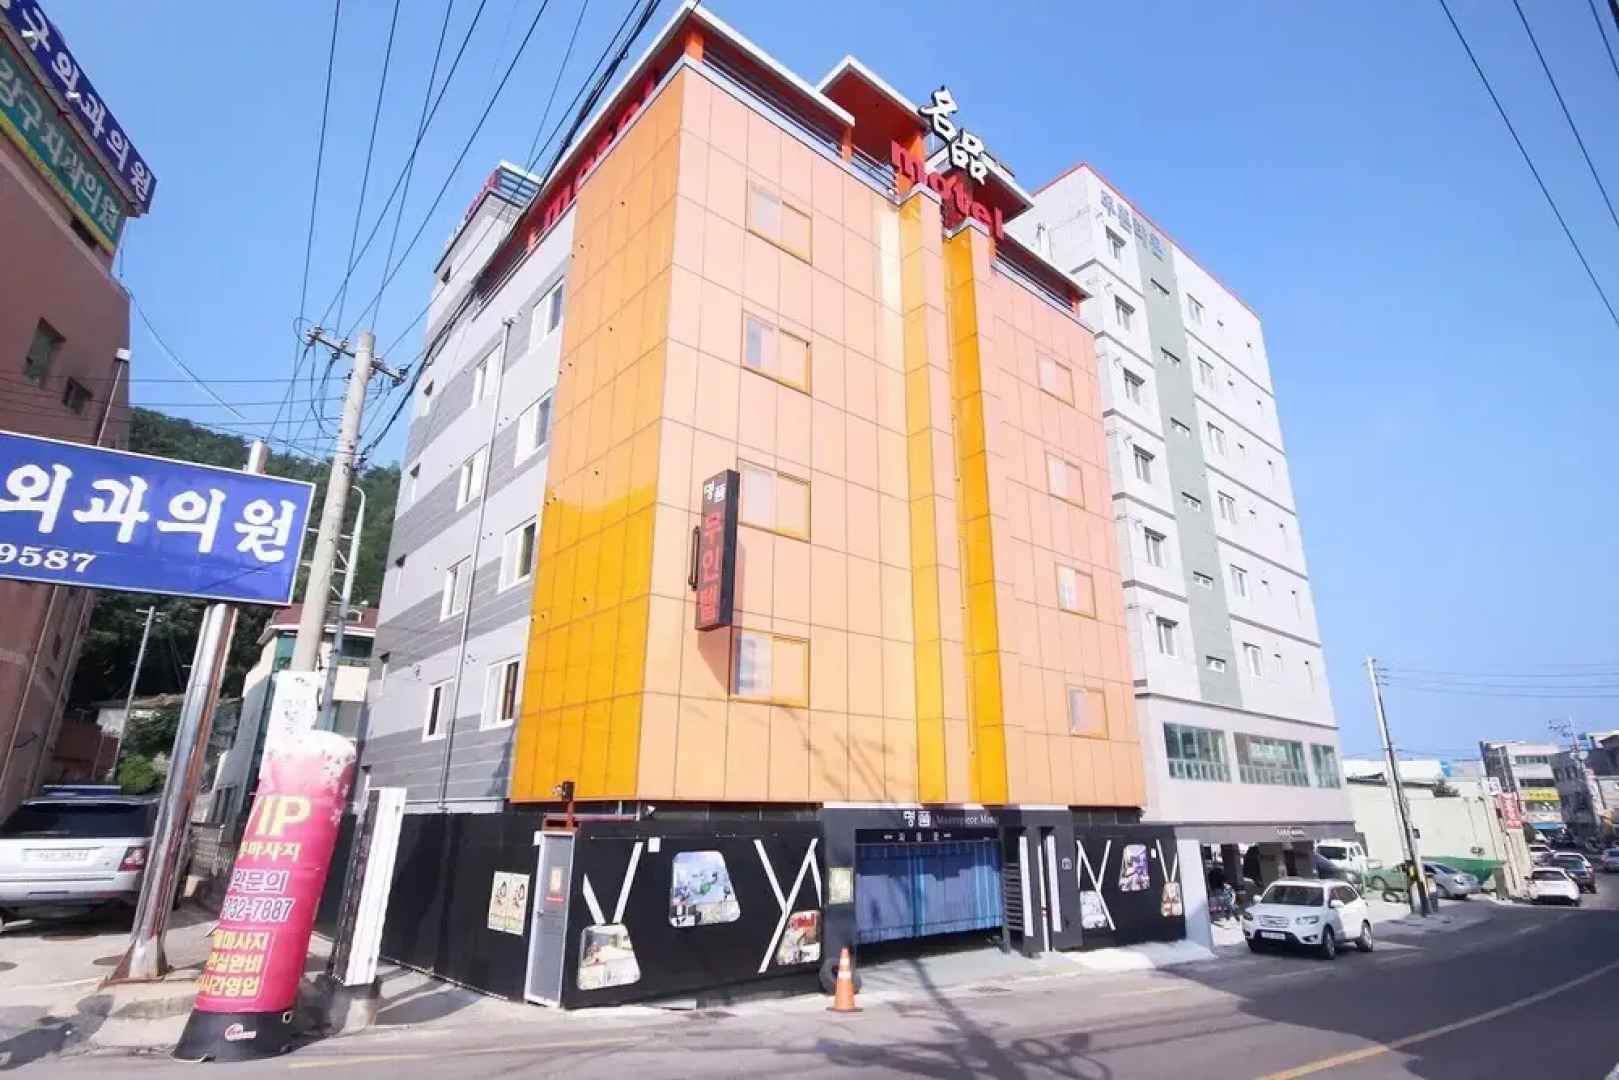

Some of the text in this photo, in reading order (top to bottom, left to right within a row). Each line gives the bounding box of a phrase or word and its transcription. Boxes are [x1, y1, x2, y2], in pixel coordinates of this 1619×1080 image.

[0, 0, 151, 201] 구외과의원
[891, 139, 1004, 240] motel
[0, 464, 296, 563] 외과의원
[0, 543, 97, 573] 9587
[246, 795, 311, 837] IP
